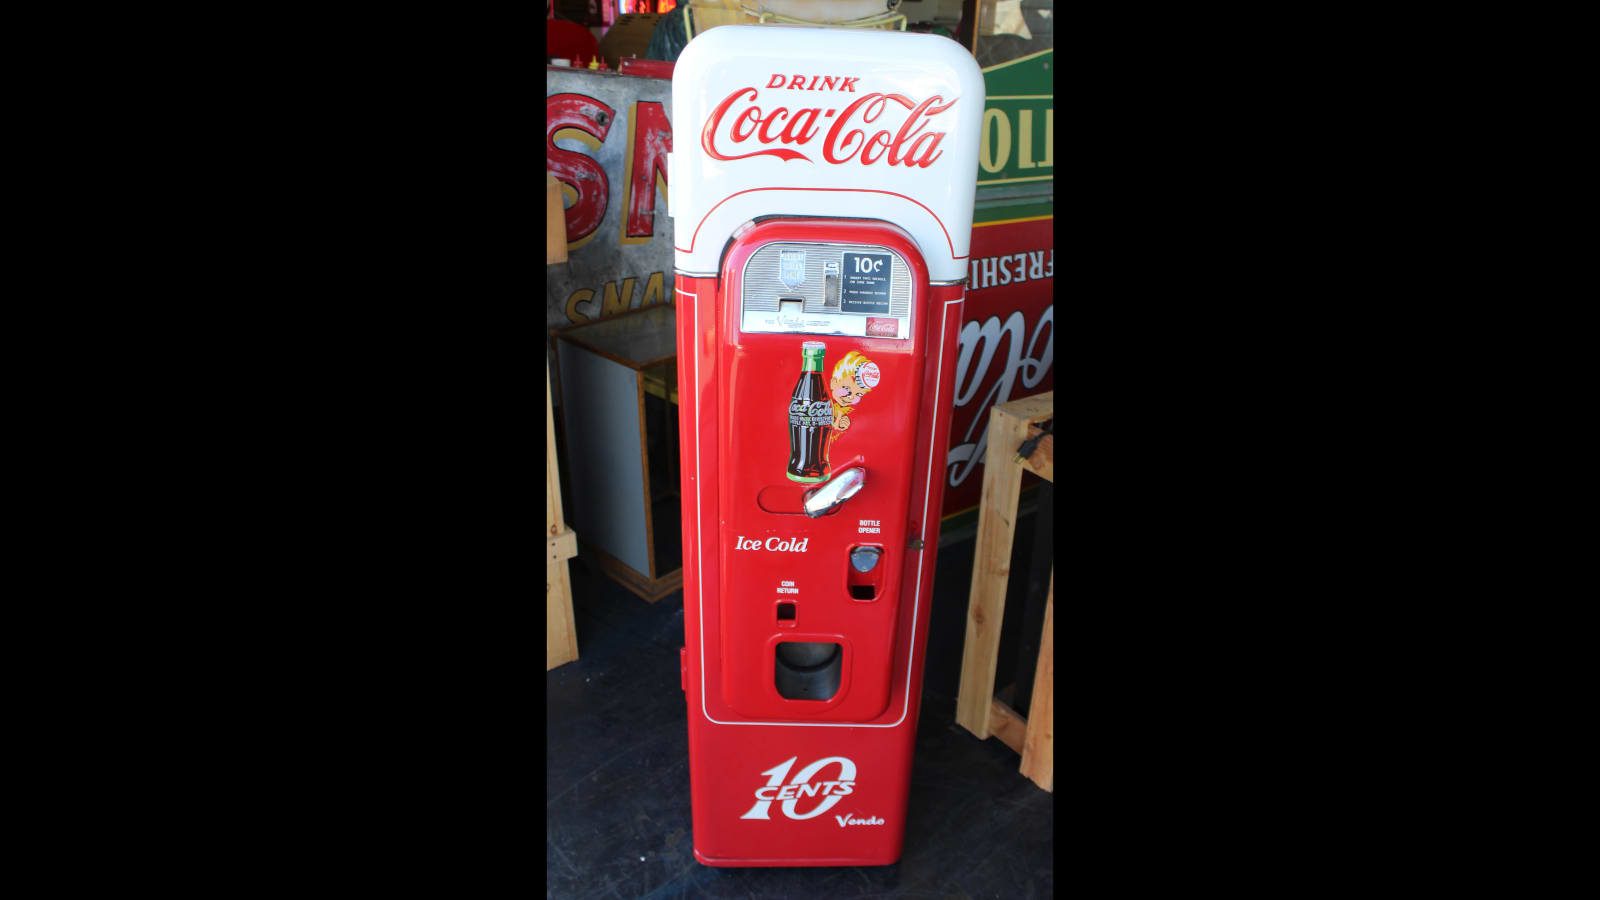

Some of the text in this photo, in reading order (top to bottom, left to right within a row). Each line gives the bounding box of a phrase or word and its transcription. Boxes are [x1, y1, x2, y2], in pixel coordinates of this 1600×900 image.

[765, 73, 860, 93] DRINK
[700, 86, 960, 169] Coca-Cola
[854, 256, 884, 274] 10¢
[859, 519, 881, 527] BOTTLE
[735, 535, 809, 553] Ice Cold
[776, 587, 799, 595] RETURN
[739, 755, 857, 820] 10
[754, 780, 856, 801] CENTS
[835, 812, 886, 828] Vendo
